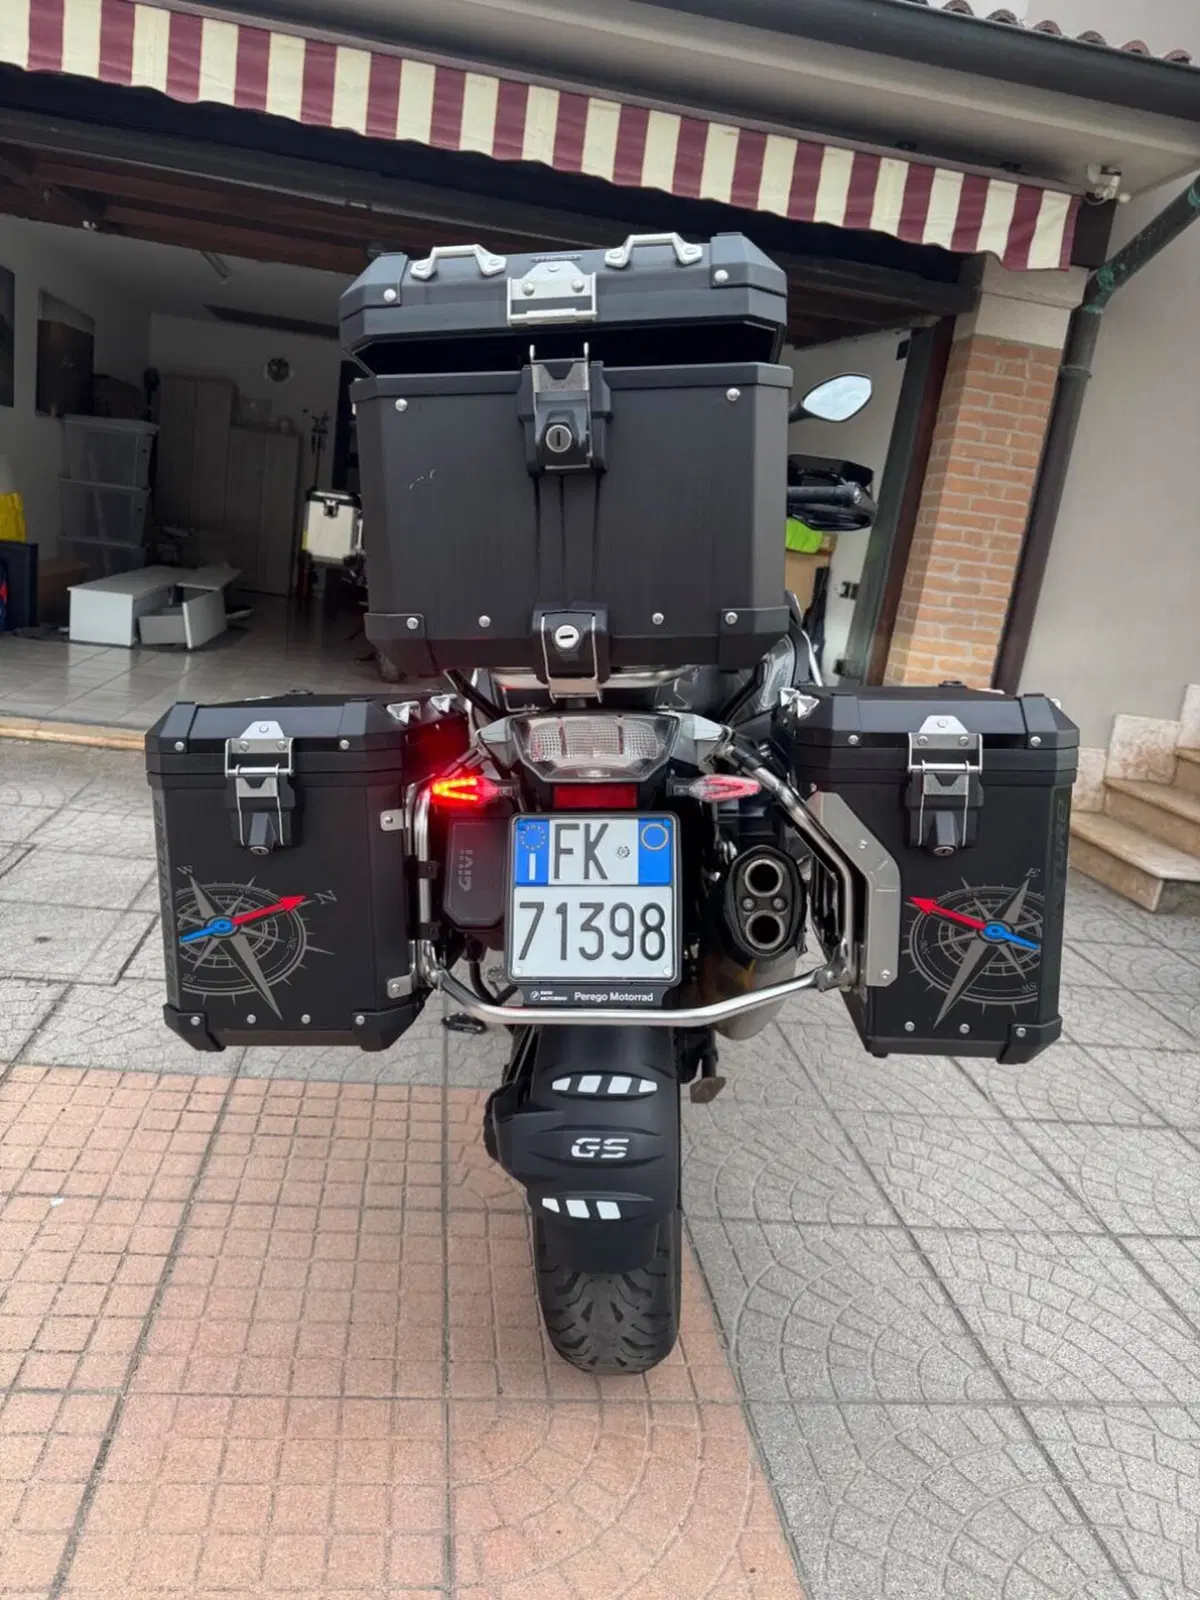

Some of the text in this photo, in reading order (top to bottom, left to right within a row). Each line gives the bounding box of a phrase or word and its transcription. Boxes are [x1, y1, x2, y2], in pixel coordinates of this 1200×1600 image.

[553, 823, 609, 880] FK
[458, 849, 473, 892] GIVI
[314, 889, 339, 905] N
[518, 902, 666, 961] 71398
[574, 991, 654, 1003] Perego Motorrad
[571, 1137, 630, 1159] GS
